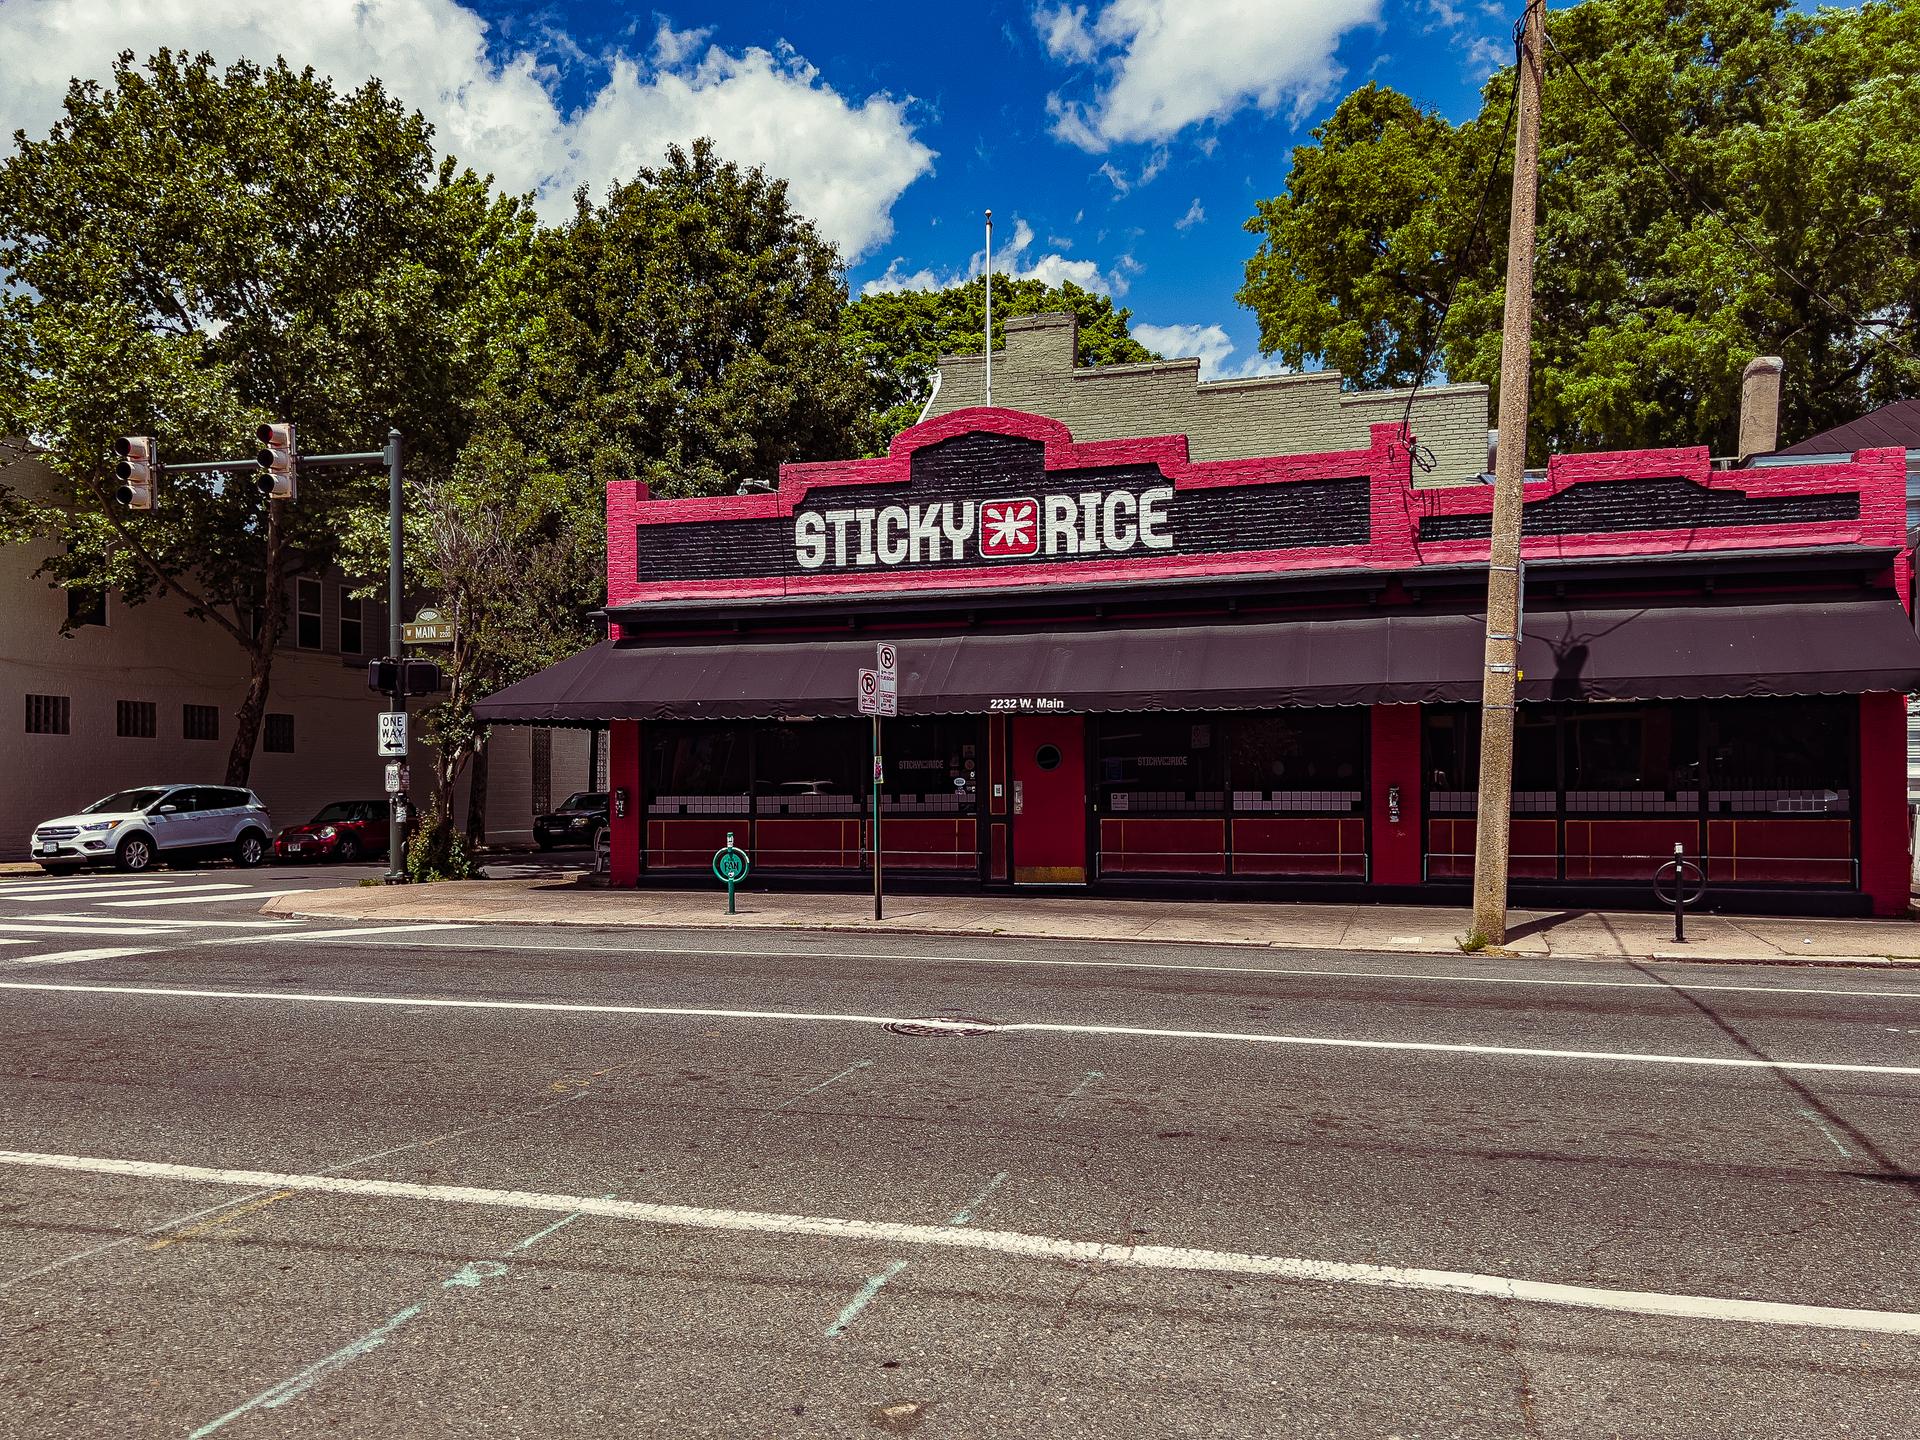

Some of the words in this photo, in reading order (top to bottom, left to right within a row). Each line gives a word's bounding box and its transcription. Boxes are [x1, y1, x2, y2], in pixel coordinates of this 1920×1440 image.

[795, 501, 974, 569] STICKY
[1044, 487, 1173, 556] RICE
[415, 626, 436, 639] MAIN
[990, 699, 1017, 709] 2232
[1019, 698, 1034, 709] W.
[1036, 698, 1064, 709] Main
[383, 717, 403, 727] ONE
[382, 728, 404, 738] WAY
[724, 861, 739, 872] FAN
